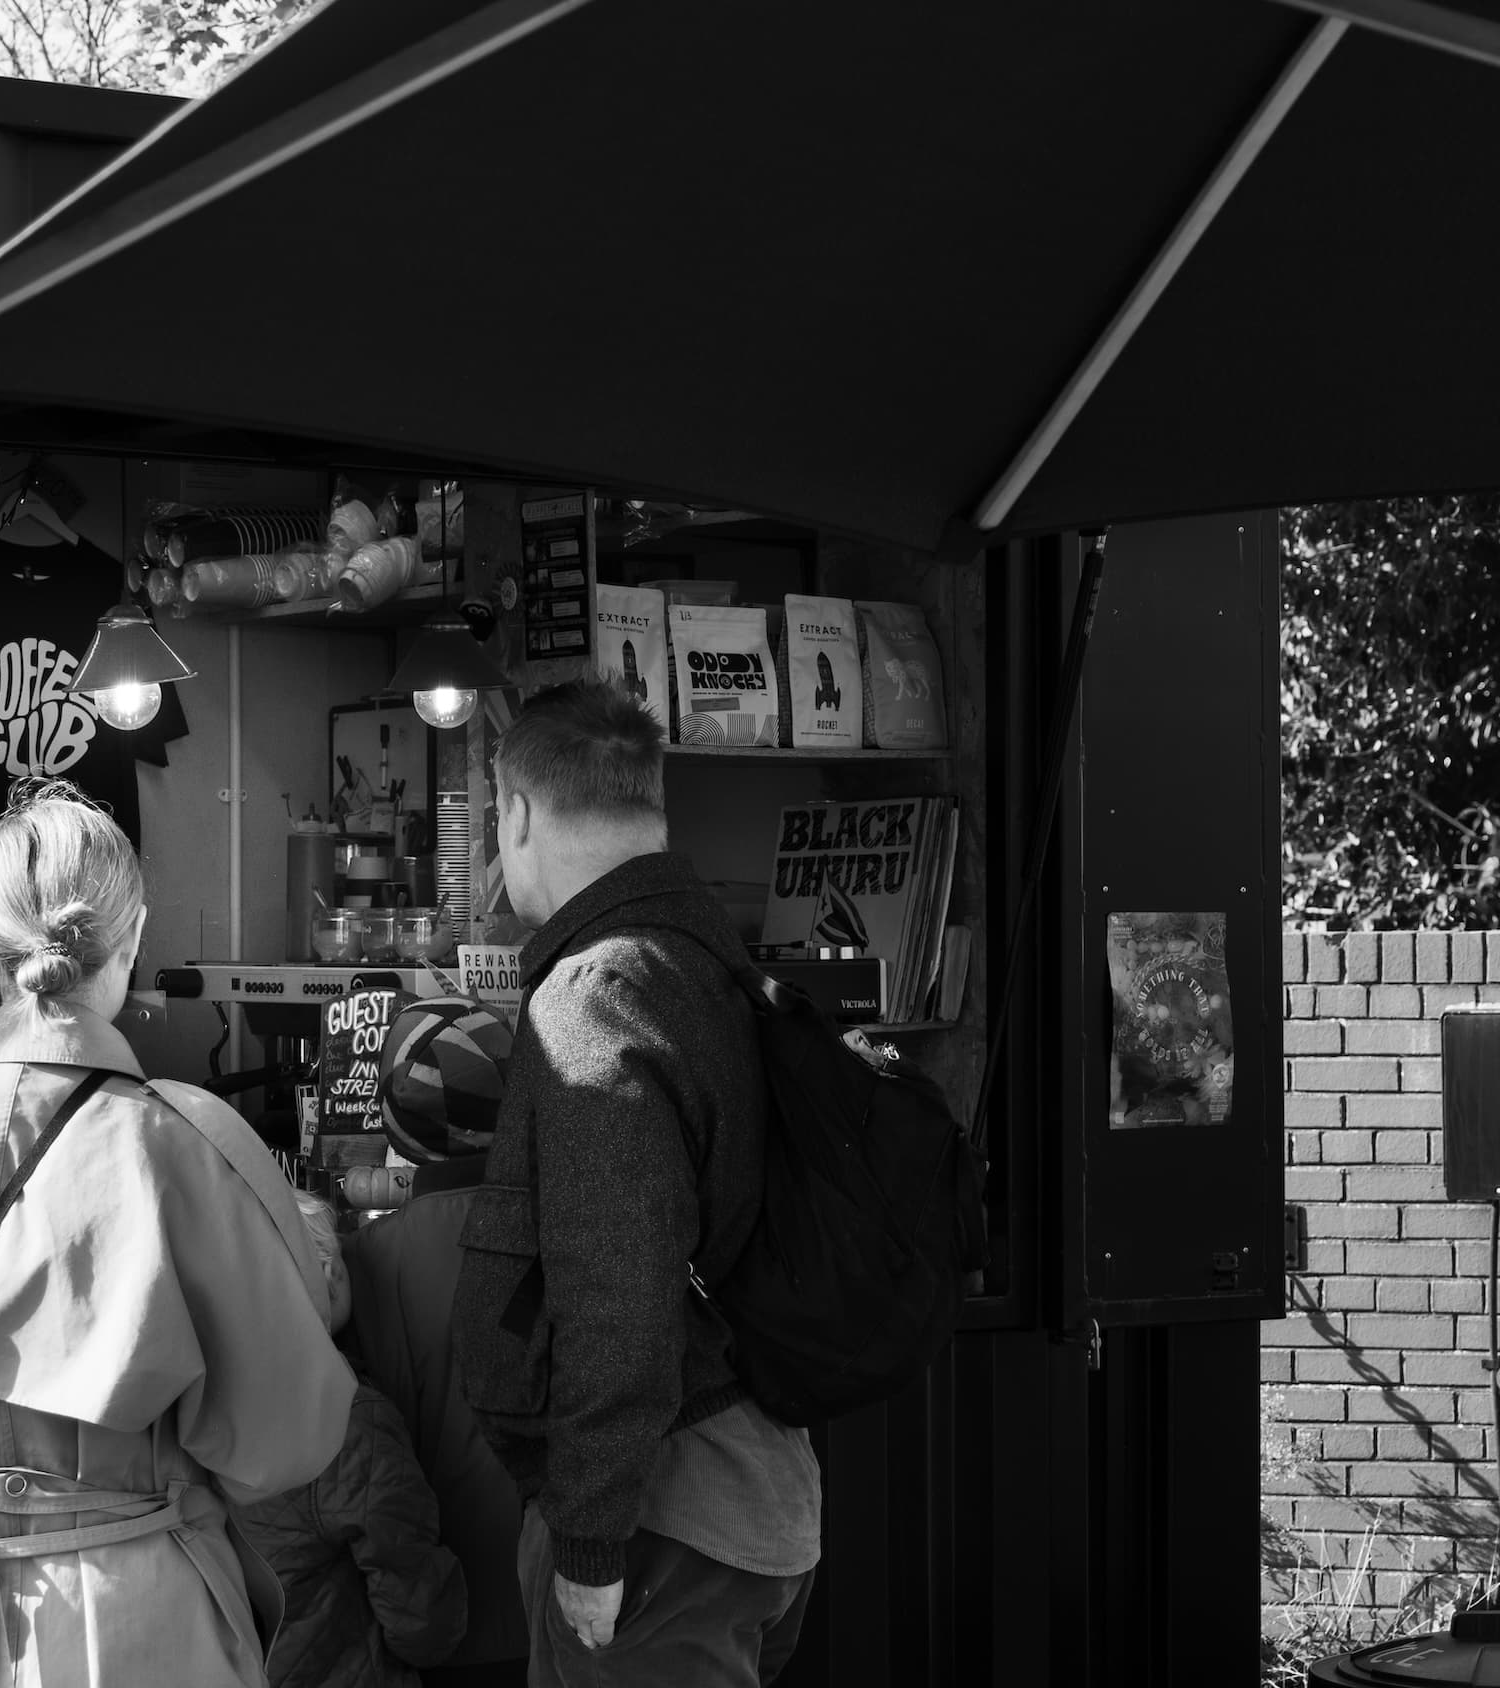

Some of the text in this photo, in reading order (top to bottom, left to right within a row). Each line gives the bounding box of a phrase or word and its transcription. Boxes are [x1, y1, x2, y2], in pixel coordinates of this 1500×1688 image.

[598, 612, 650, 627] EXTRACT
[800, 623, 842, 636] EXTRACT
[817, 719, 838, 730] ROCKET
[779, 803, 915, 852] BLACK
[774, 850, 910, 899] UHURU
[465, 954, 516, 967] REWAR
[1135, 970, 1210, 1018] SOMETHING THAT
[328, 991, 396, 1035] GUEST
[841, 999, 877, 1009] VICTROLA
[352, 1026, 390, 1054] COF
[331, 1078, 378, 1096] STRE
